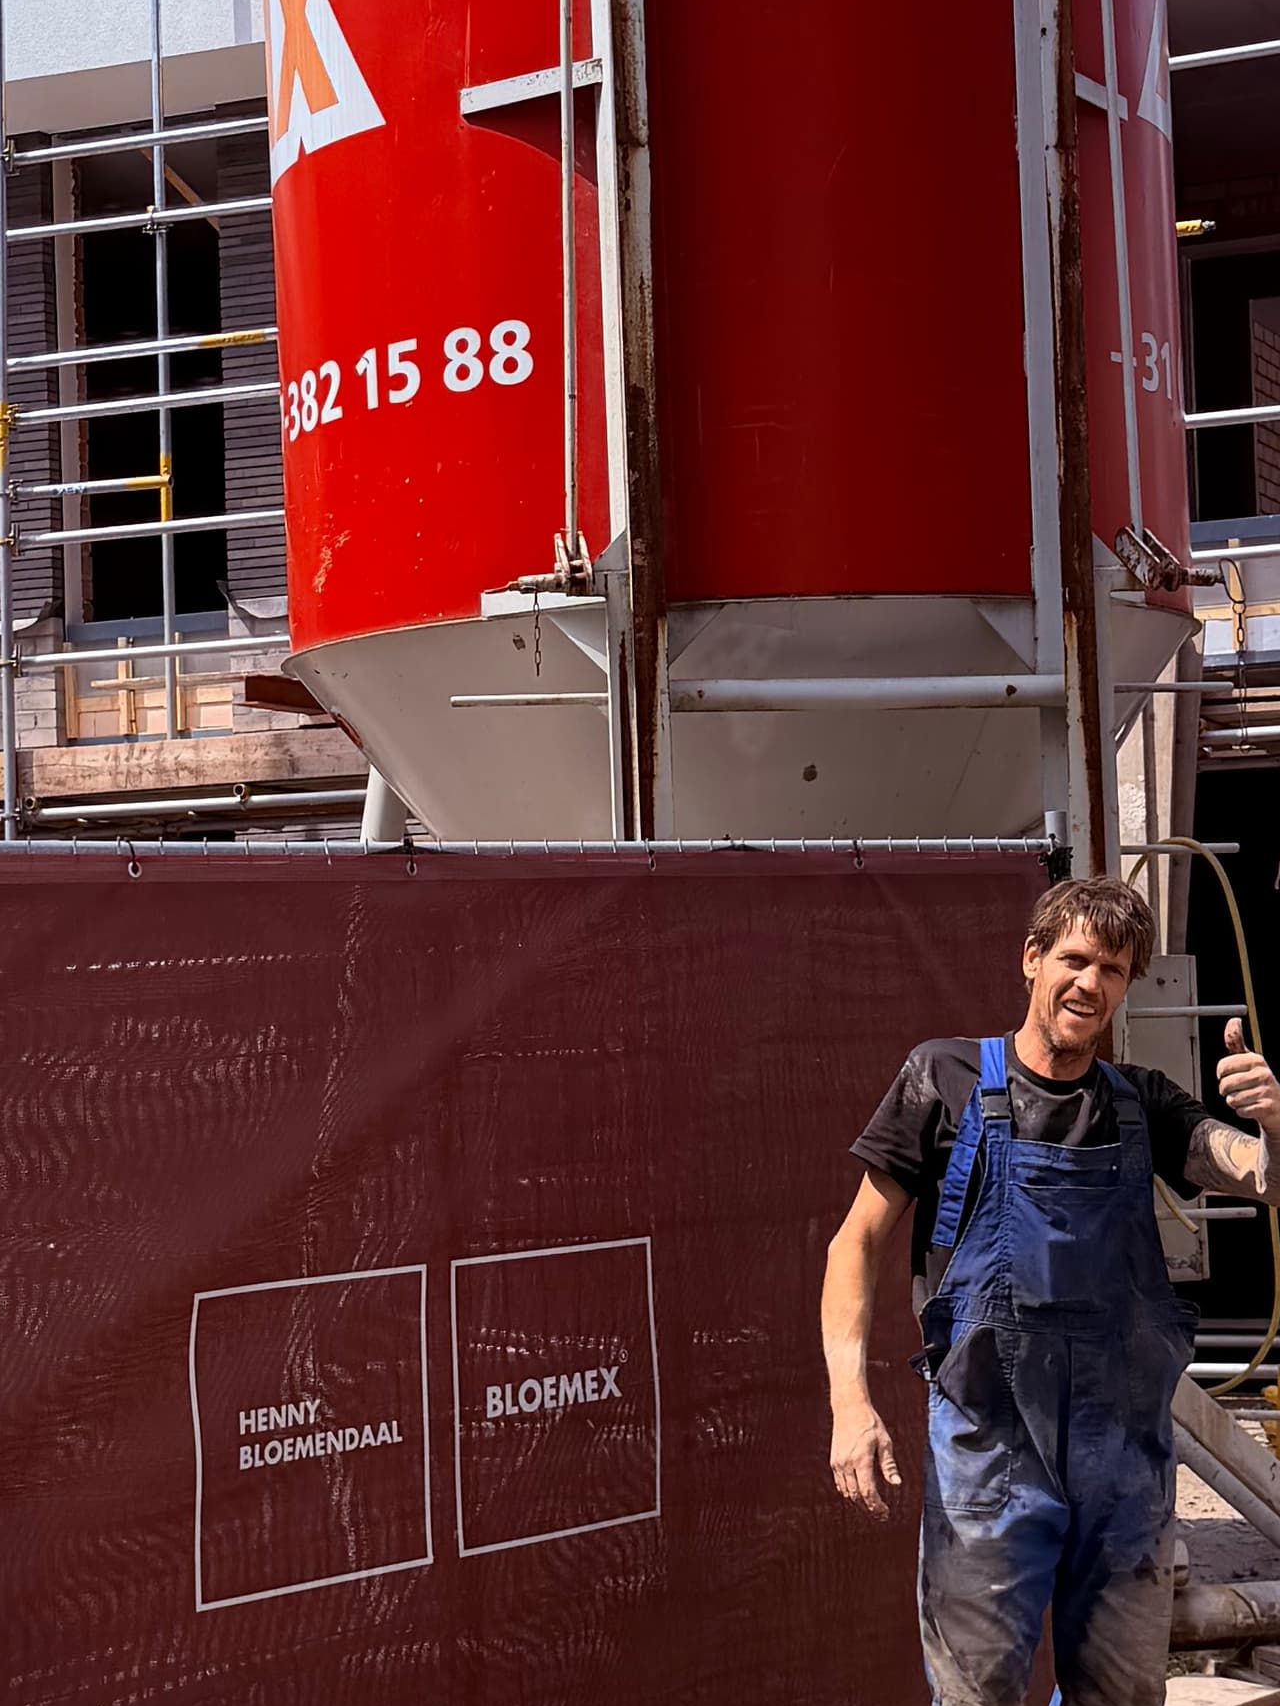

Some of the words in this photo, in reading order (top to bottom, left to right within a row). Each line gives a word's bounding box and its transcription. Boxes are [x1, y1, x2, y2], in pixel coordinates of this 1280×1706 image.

[355, 338, 421, 410] 15
[443, 319, 534, 393] 88
[238, 1399, 321, 1436] HENNY
[238, 1420, 404, 1471] BLOEMENDAAL
